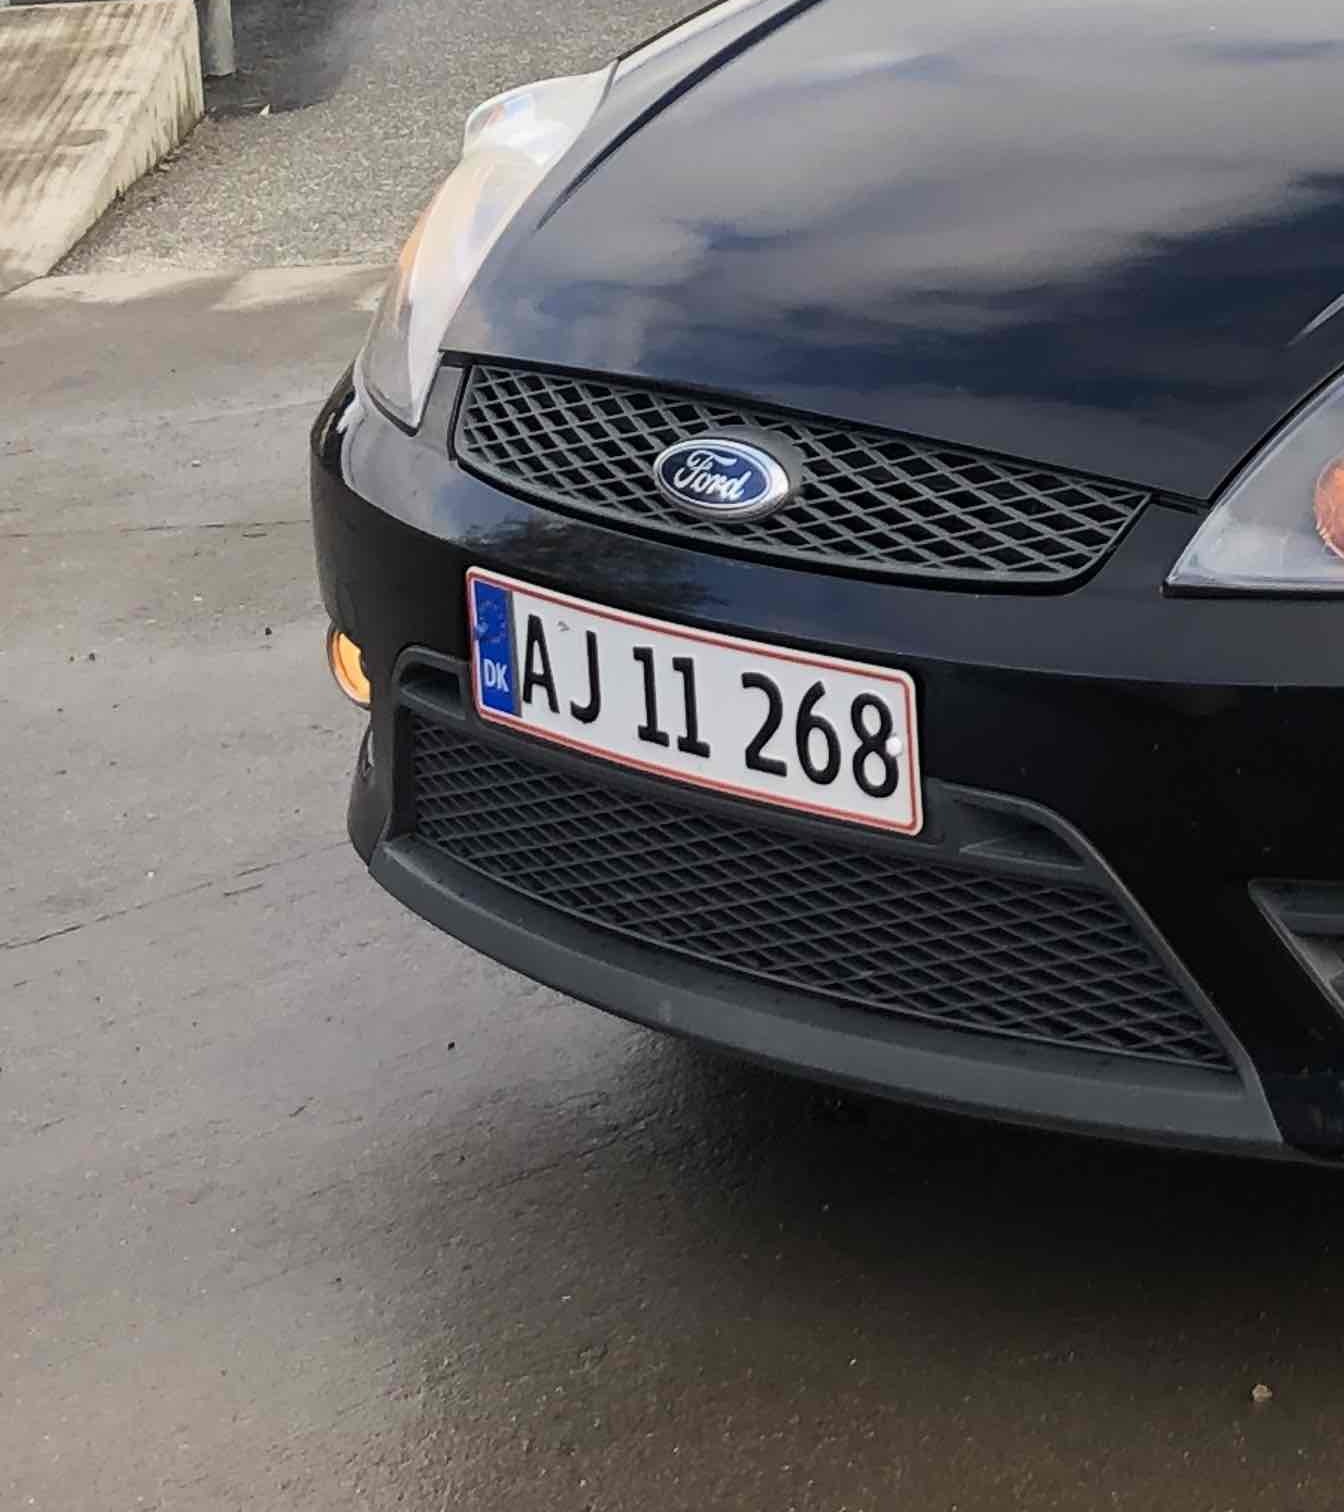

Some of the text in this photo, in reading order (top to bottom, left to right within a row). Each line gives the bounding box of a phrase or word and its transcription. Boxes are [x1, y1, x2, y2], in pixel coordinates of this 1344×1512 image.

[672, 451, 747, 503] Ford
[483, 658, 510, 693] DK
[522, 613, 900, 799] AJ 11 268
